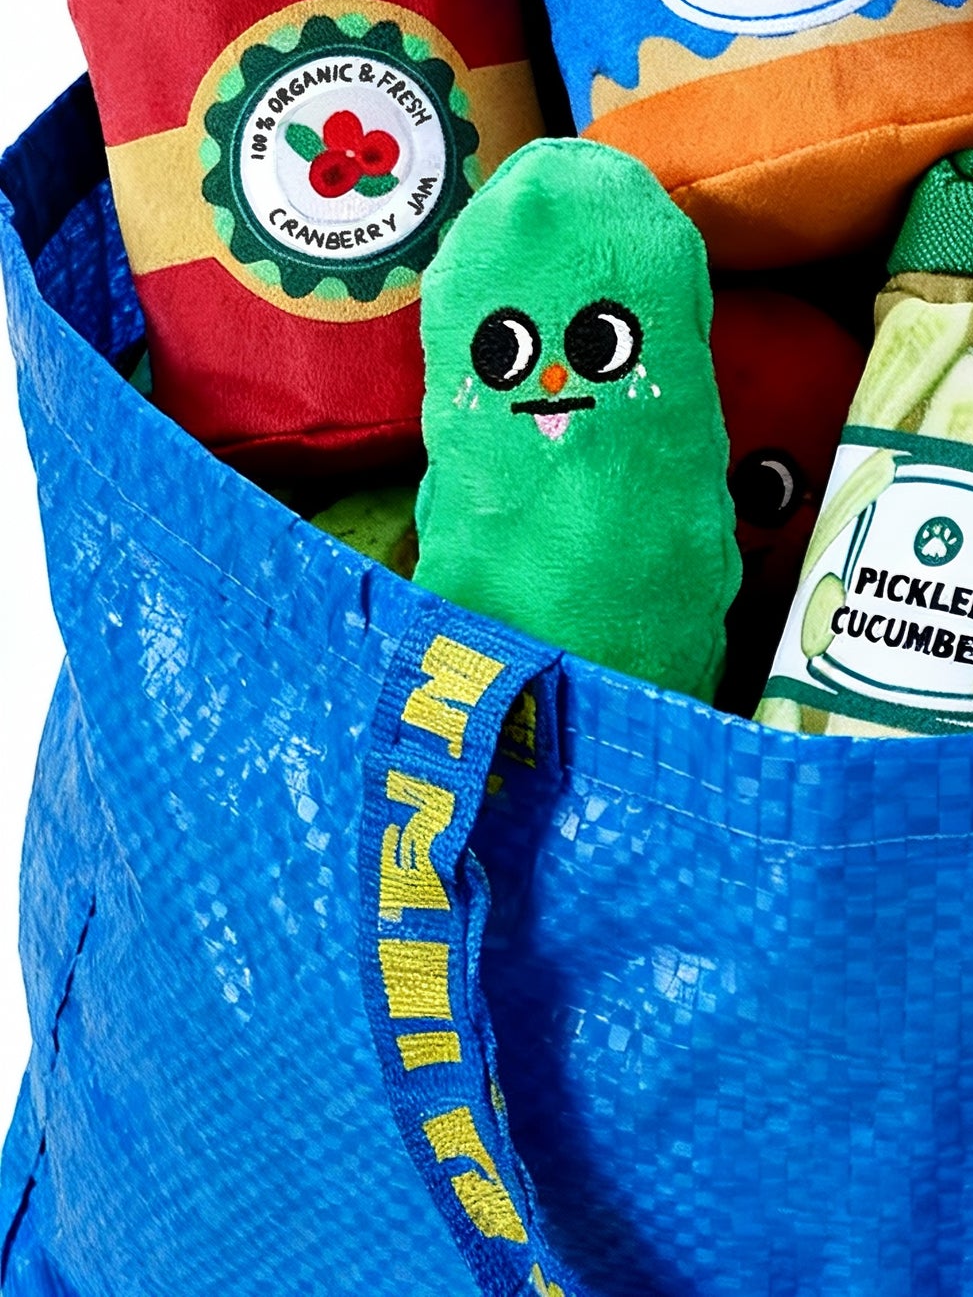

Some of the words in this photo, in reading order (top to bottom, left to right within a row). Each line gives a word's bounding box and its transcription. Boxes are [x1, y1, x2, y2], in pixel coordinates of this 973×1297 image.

[268, 63, 353, 113] ORGANIC
[358, 63, 376, 83] &
[377, 70, 433, 126] FRESH
[269, 208, 397, 250] CRANBERRY
[407, 177, 438, 216] JAM
